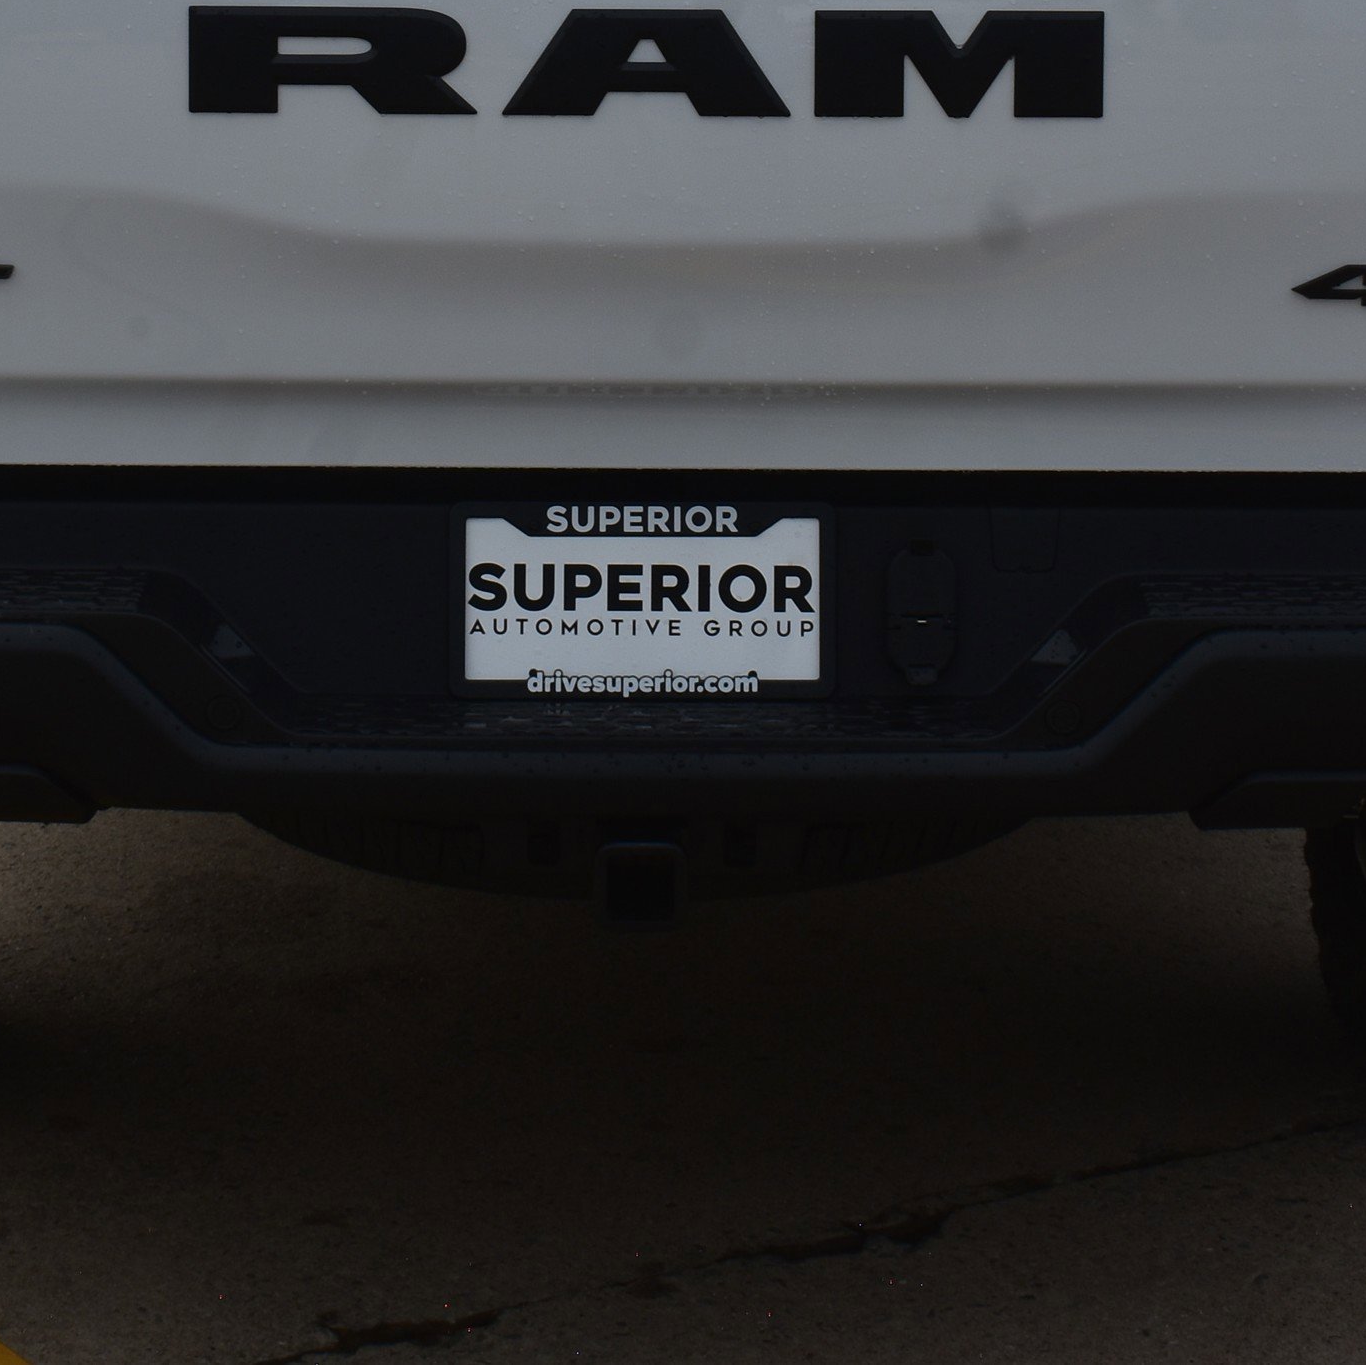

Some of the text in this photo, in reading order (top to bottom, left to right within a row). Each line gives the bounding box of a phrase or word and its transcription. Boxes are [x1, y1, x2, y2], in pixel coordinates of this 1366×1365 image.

[188, 6, 1105, 119] RAM
[546, 505, 739, 533] SUPERIOR
[468, 562, 816, 613] SUPERIOR
[469, 618, 814, 637] AUTOMOTIVE GROUP
[527, 669, 758, 697] drivesuperior.com
